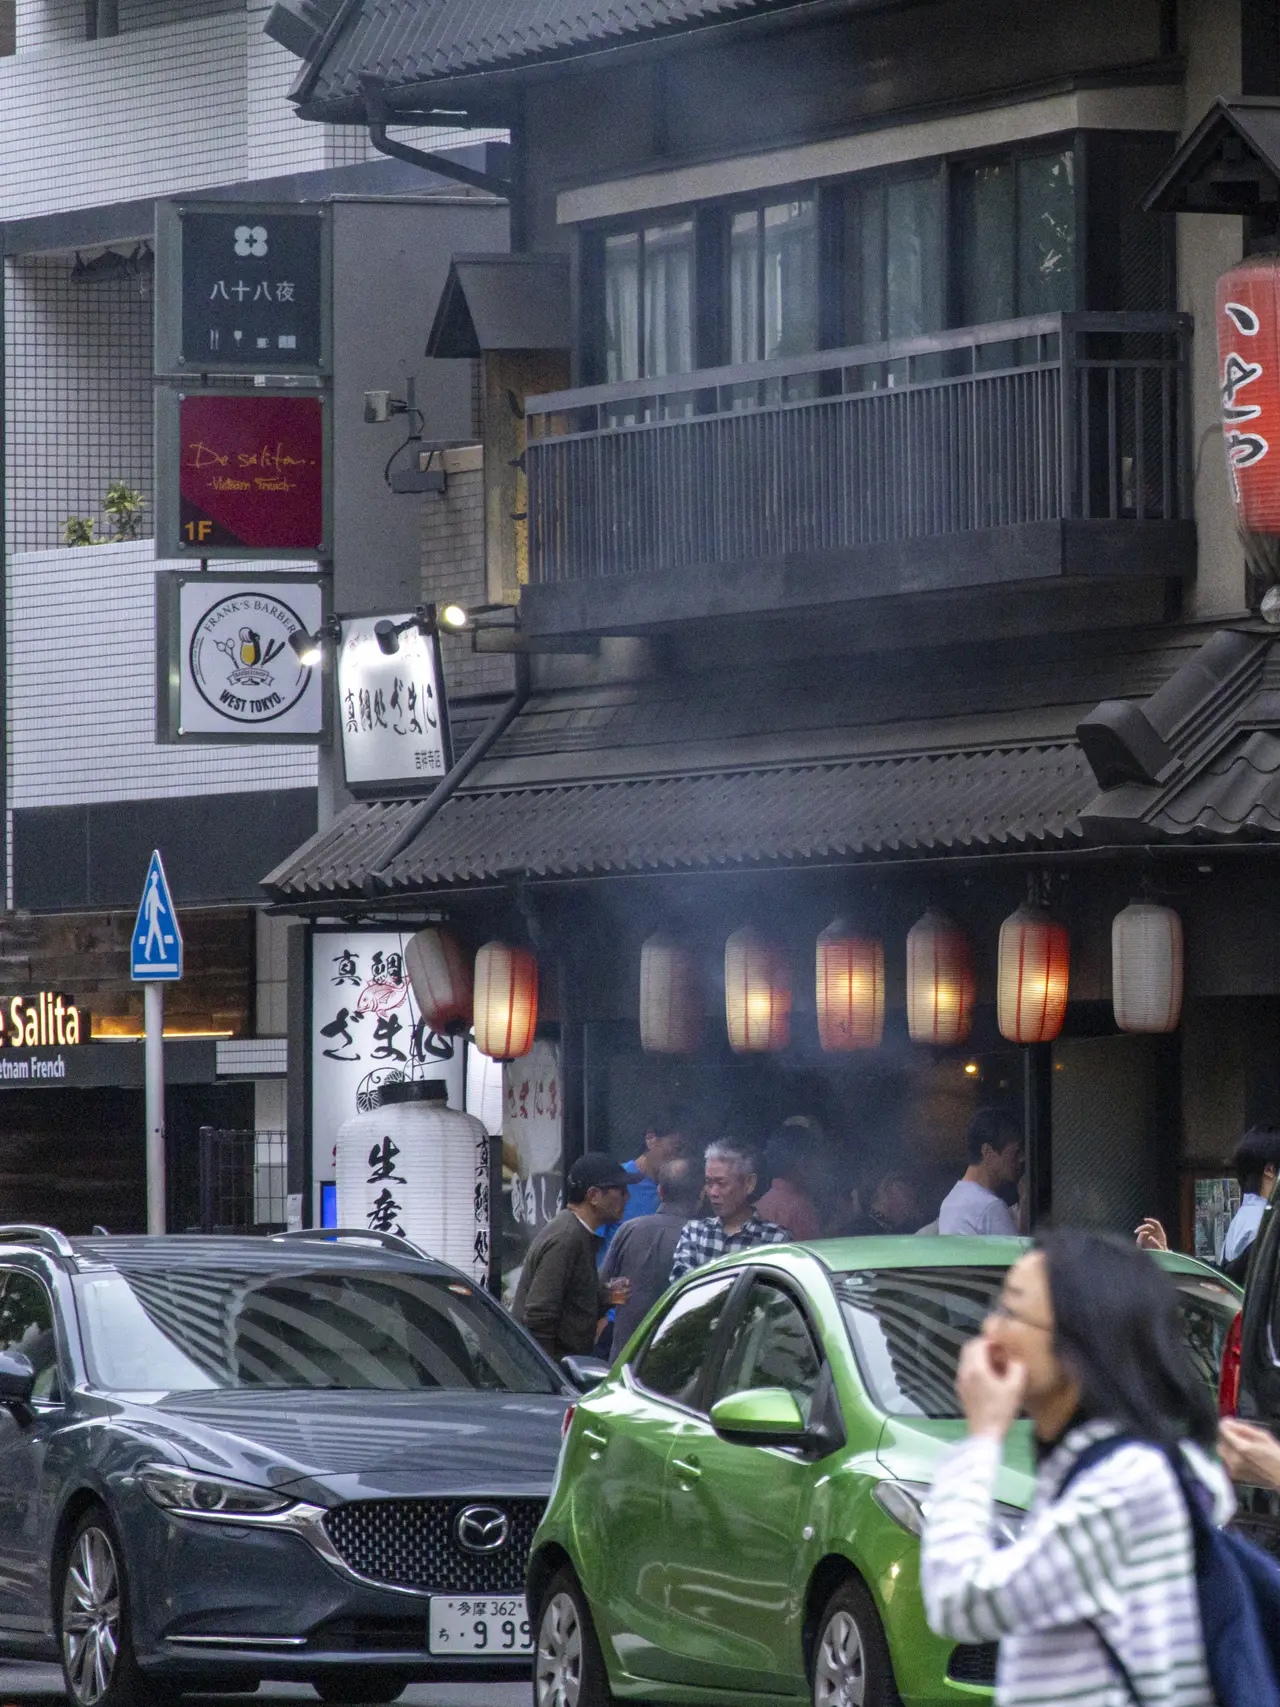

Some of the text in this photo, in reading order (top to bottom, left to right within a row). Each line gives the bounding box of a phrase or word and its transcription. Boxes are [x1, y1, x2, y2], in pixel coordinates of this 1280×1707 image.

[210, 280, 297, 302] 八十八夜
[185, 520, 212, 541] 1F
[204, 600, 297, 634] FRANK'S BARBER
[219, 689, 247, 713] WEST
[331, 949, 404, 987] 真鯛
[10, 991, 80, 1047] Salita
[30, 1054, 65, 1077] French
[457, 1601, 516, 1616] 多摩 362
[438, 1627, 450, 1642] ち
